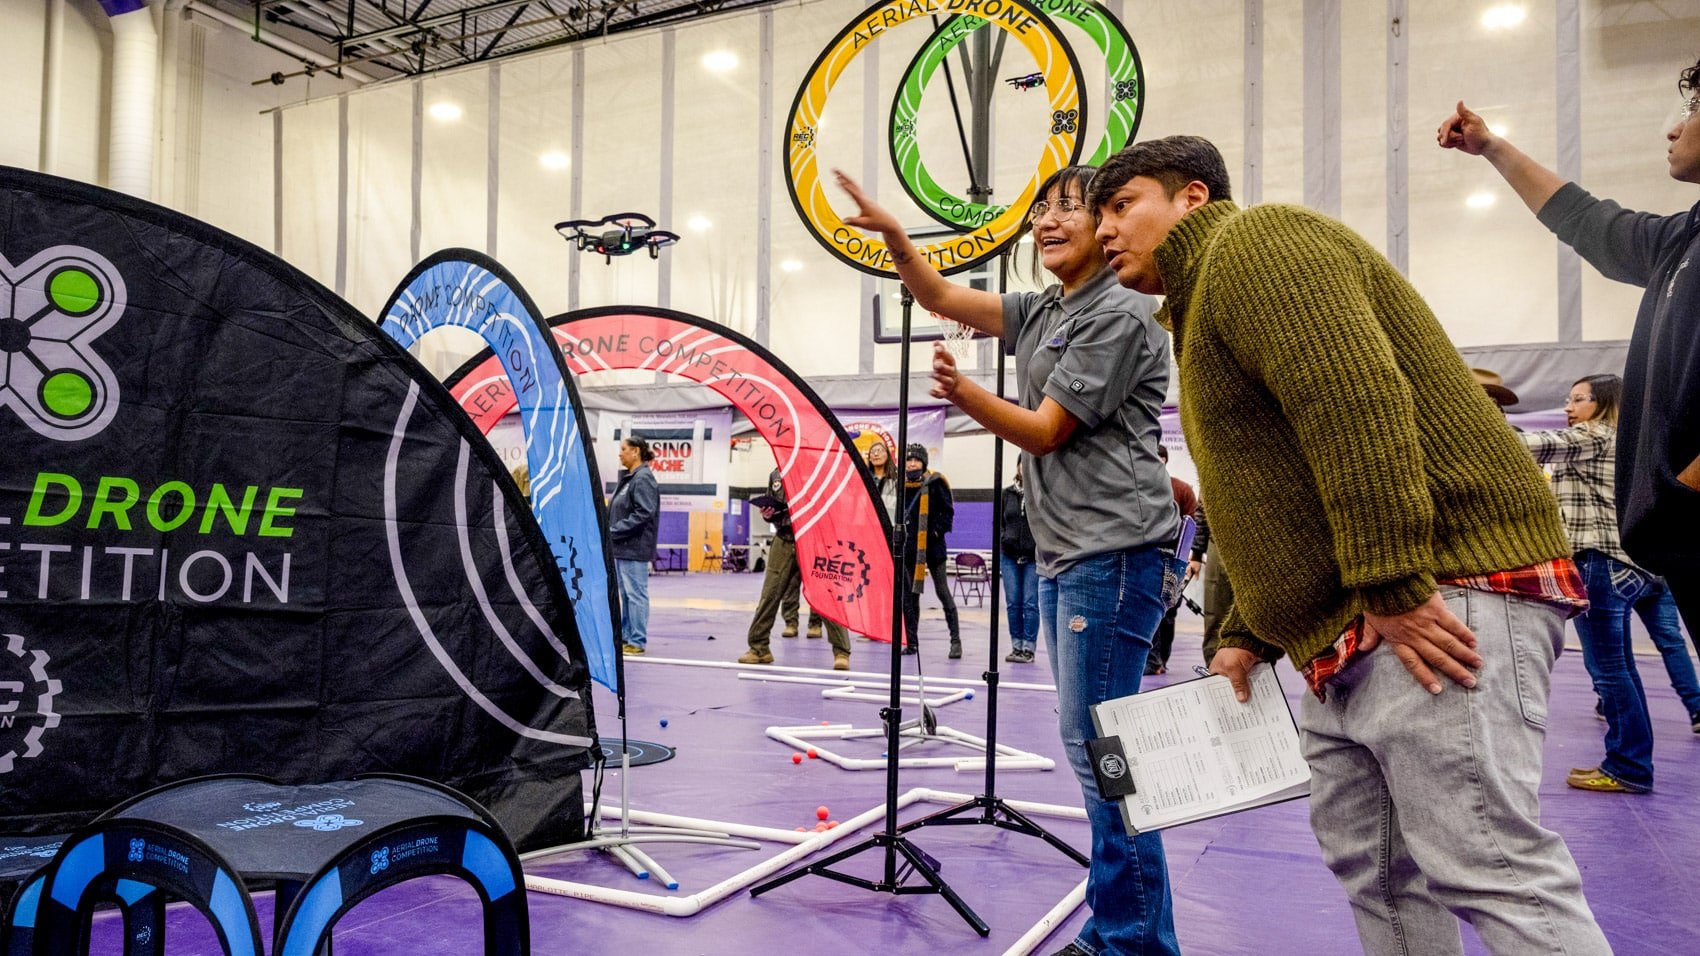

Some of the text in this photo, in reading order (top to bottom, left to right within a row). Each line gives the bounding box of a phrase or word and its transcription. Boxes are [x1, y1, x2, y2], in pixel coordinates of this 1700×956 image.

[853, 0, 938, 49] AERIAL
[940, 14, 982, 51] AER
[833, 227, 996, 268] COMPITION
[562, 334, 631, 360] RONE
[639, 336, 790, 439] COMPETITION
[646, 442, 692, 458] SINO
[648, 459, 685, 472] ACHE
[23, 472, 304, 538] DRONE
[813, 556, 855, 576] REC
[811, 571, 853, 583] FOUNDATION
[147, 844, 191, 865] AERIAL DRONE
[392, 837, 439, 854] AERIAL DRONE
[392, 846, 439, 862] COMPETITION
[146, 852, 189, 875] COMPETITION
[526, 883, 569, 896] HARLOTTE
